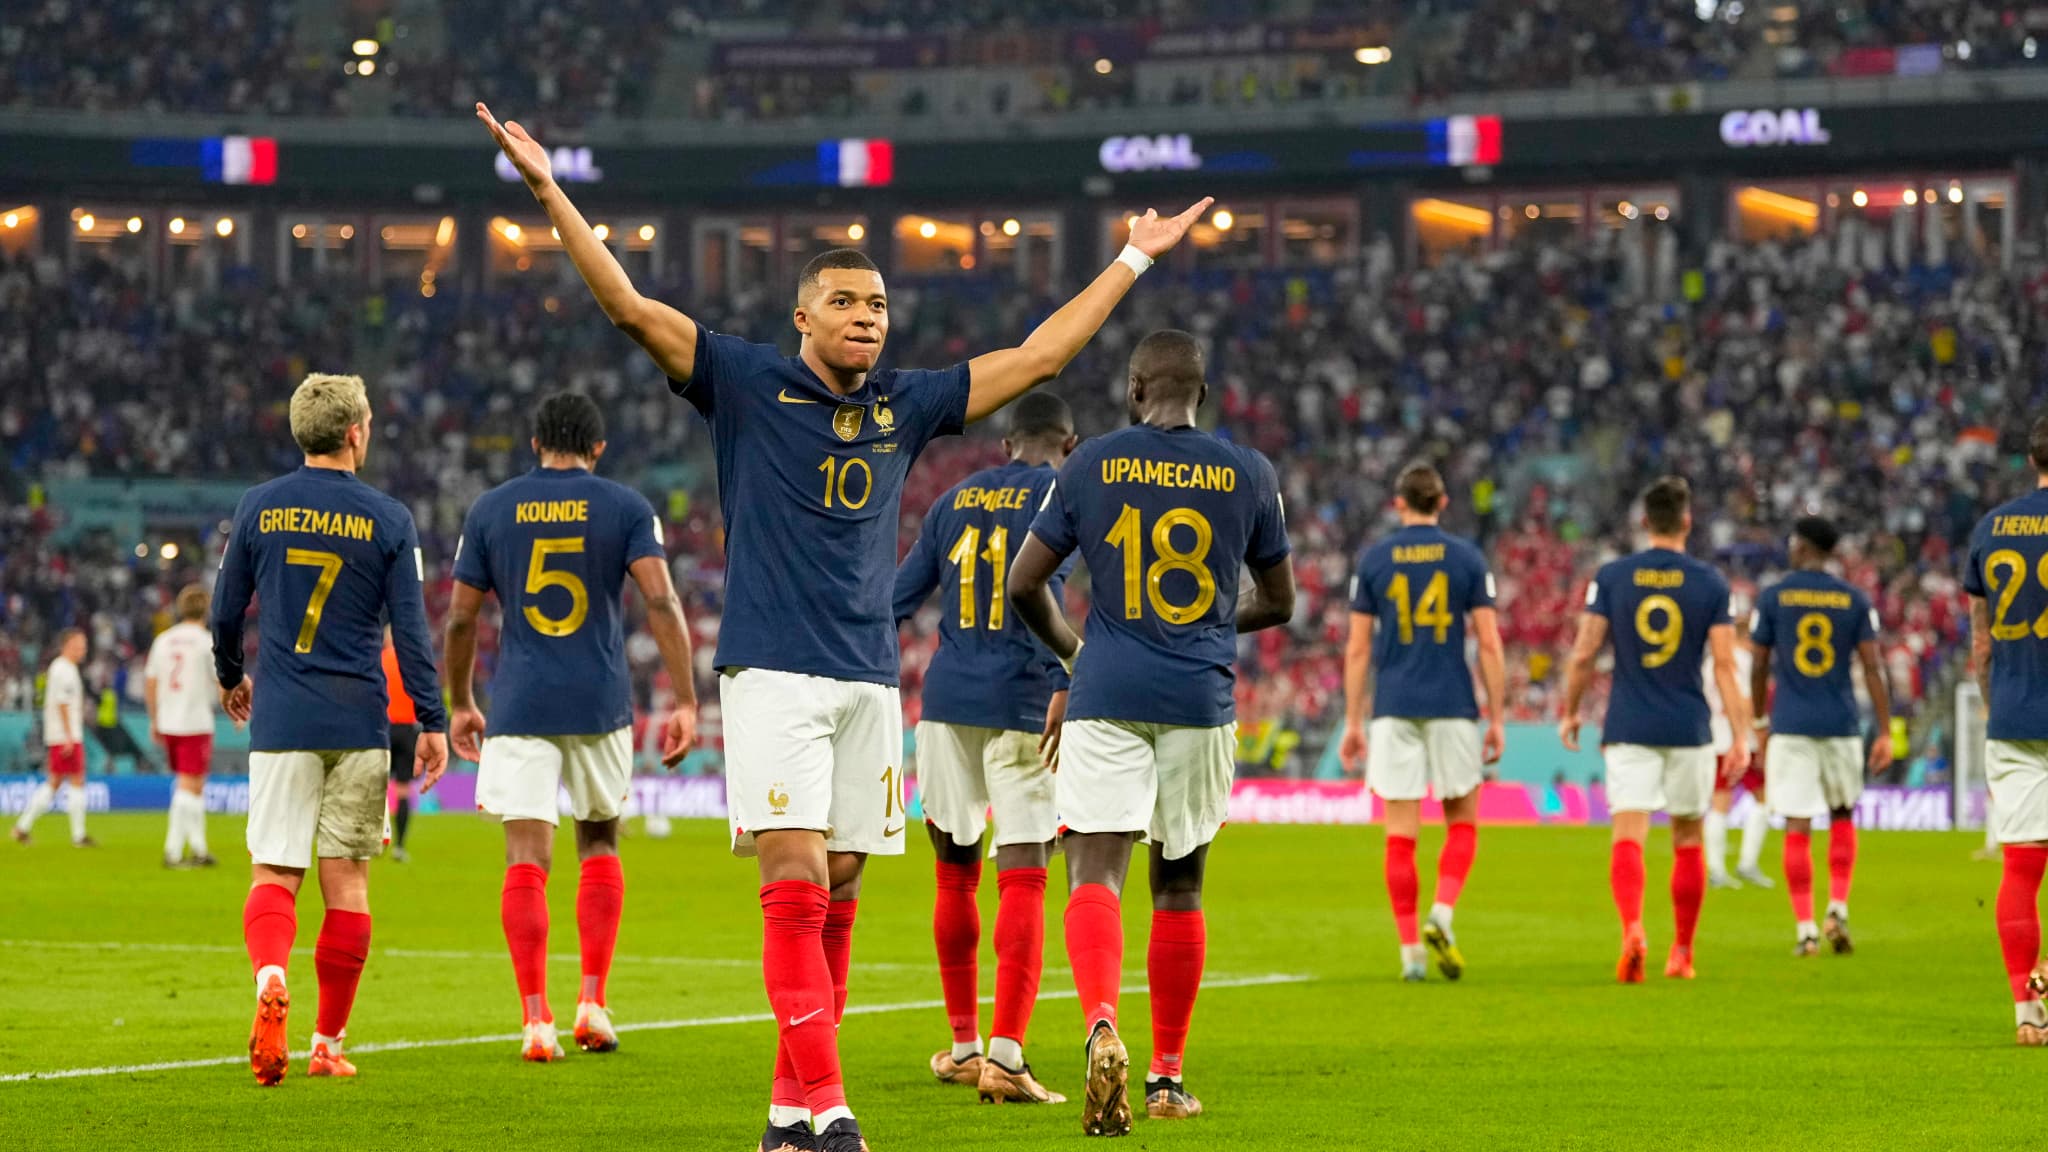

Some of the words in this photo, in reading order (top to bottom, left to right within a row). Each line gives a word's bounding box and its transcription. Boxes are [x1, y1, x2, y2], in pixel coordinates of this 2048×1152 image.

[1098, 134, 1202, 173] GOAL
[1719, 109, 1830, 147] GOAL
[494, 146, 602, 182] GAL
[818, 455, 873, 510] 10
[1101, 457, 1236, 492] UPAMECANO
[259, 507, 374, 542] GRIEZMANN
[515, 500, 589, 524] KOUNDE
[522, 536, 589, 637] 5
[947, 523, 1009, 631] 11
[1104, 502, 1217, 625] 18
[285, 547, 344, 654] 7
[1385, 570, 1454, 645] 14
[1634, 594, 1684, 669] 9
[1793, 611, 1836, 678] 8
